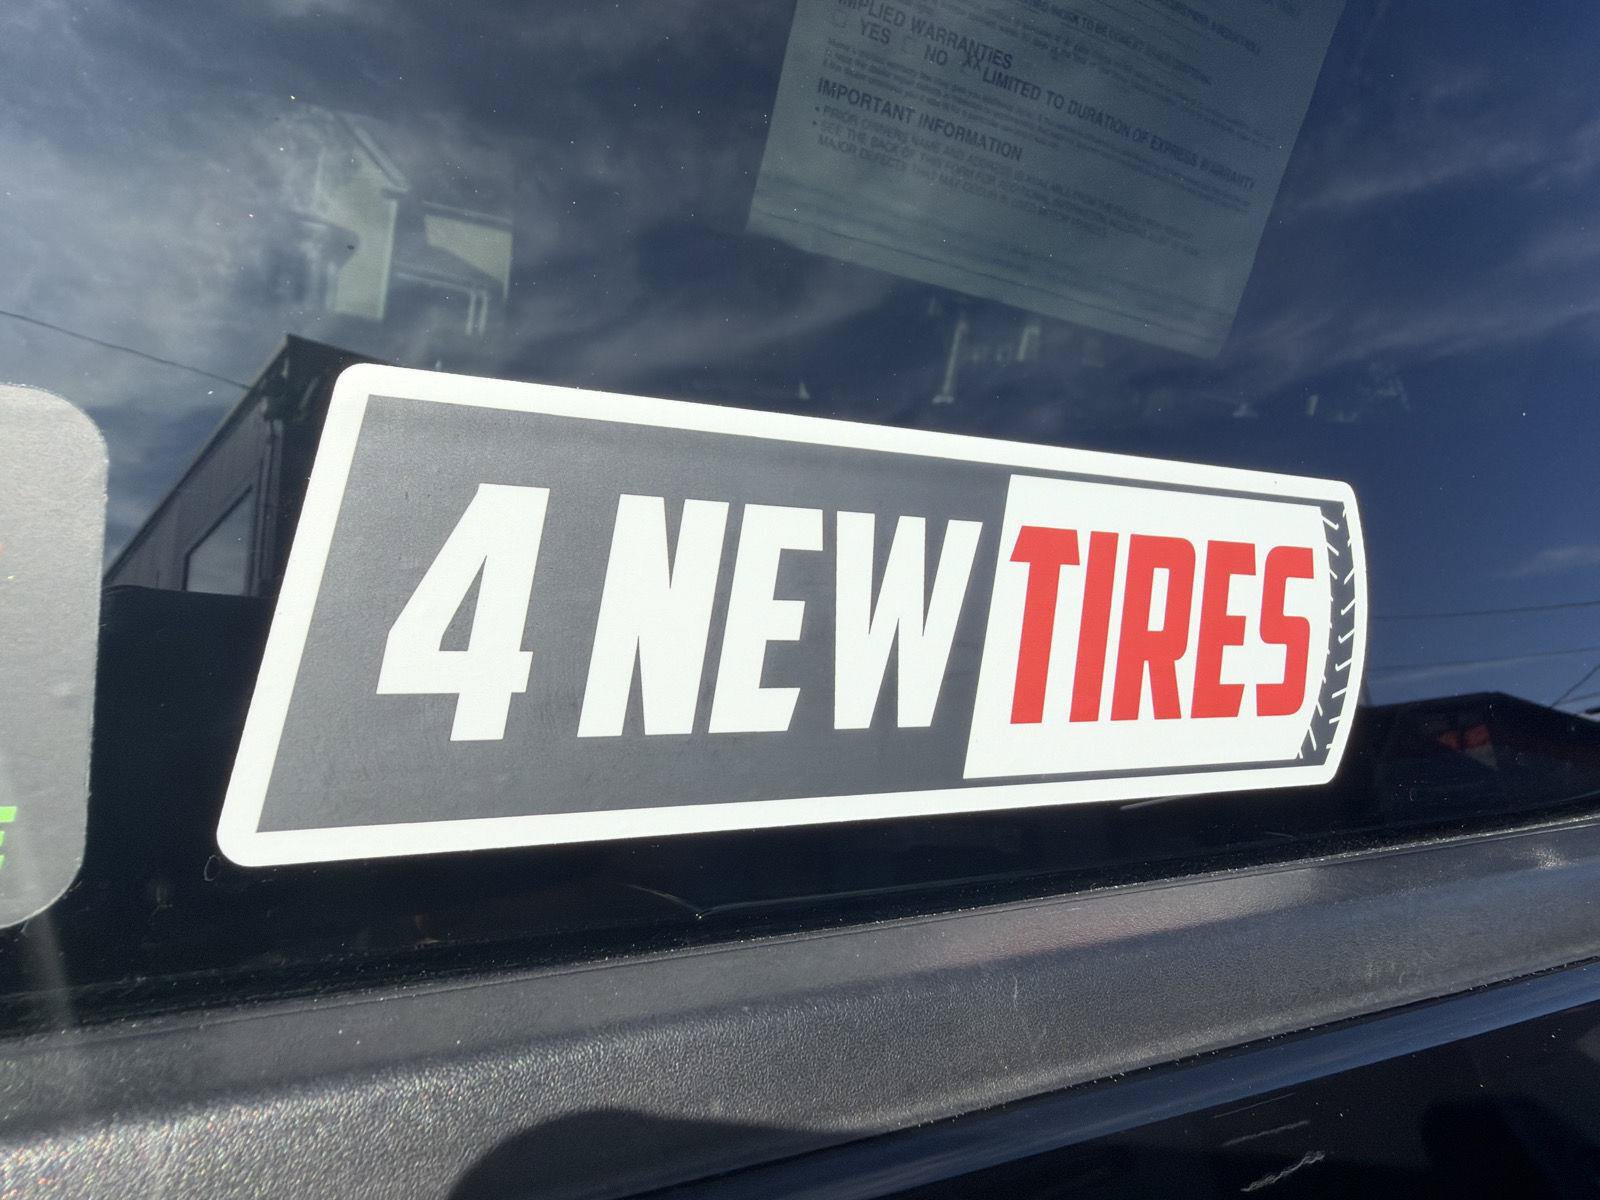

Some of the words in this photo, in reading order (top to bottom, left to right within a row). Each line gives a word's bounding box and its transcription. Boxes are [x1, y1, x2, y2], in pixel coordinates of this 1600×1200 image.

[860, 18, 891, 45] YES
[924, 44, 949, 67] NO
[982, 66, 1042, 102] LIMITED
[1046, 90, 1066, 111] TO
[1067, 99, 1131, 138] DURATION
[1132, 127, 1151, 144] OF
[1150, 134, 1198, 168] EXPRESS
[910, 16, 1014, 70] WARRANTIES
[816, 76, 916, 124] IMPORTANT
[918, 112, 1024, 162] INFORMATION
[376, 482, 550, 742] 4
[577, 493, 984, 739] NEW
[1010, 525, 1315, 725] TIRES
